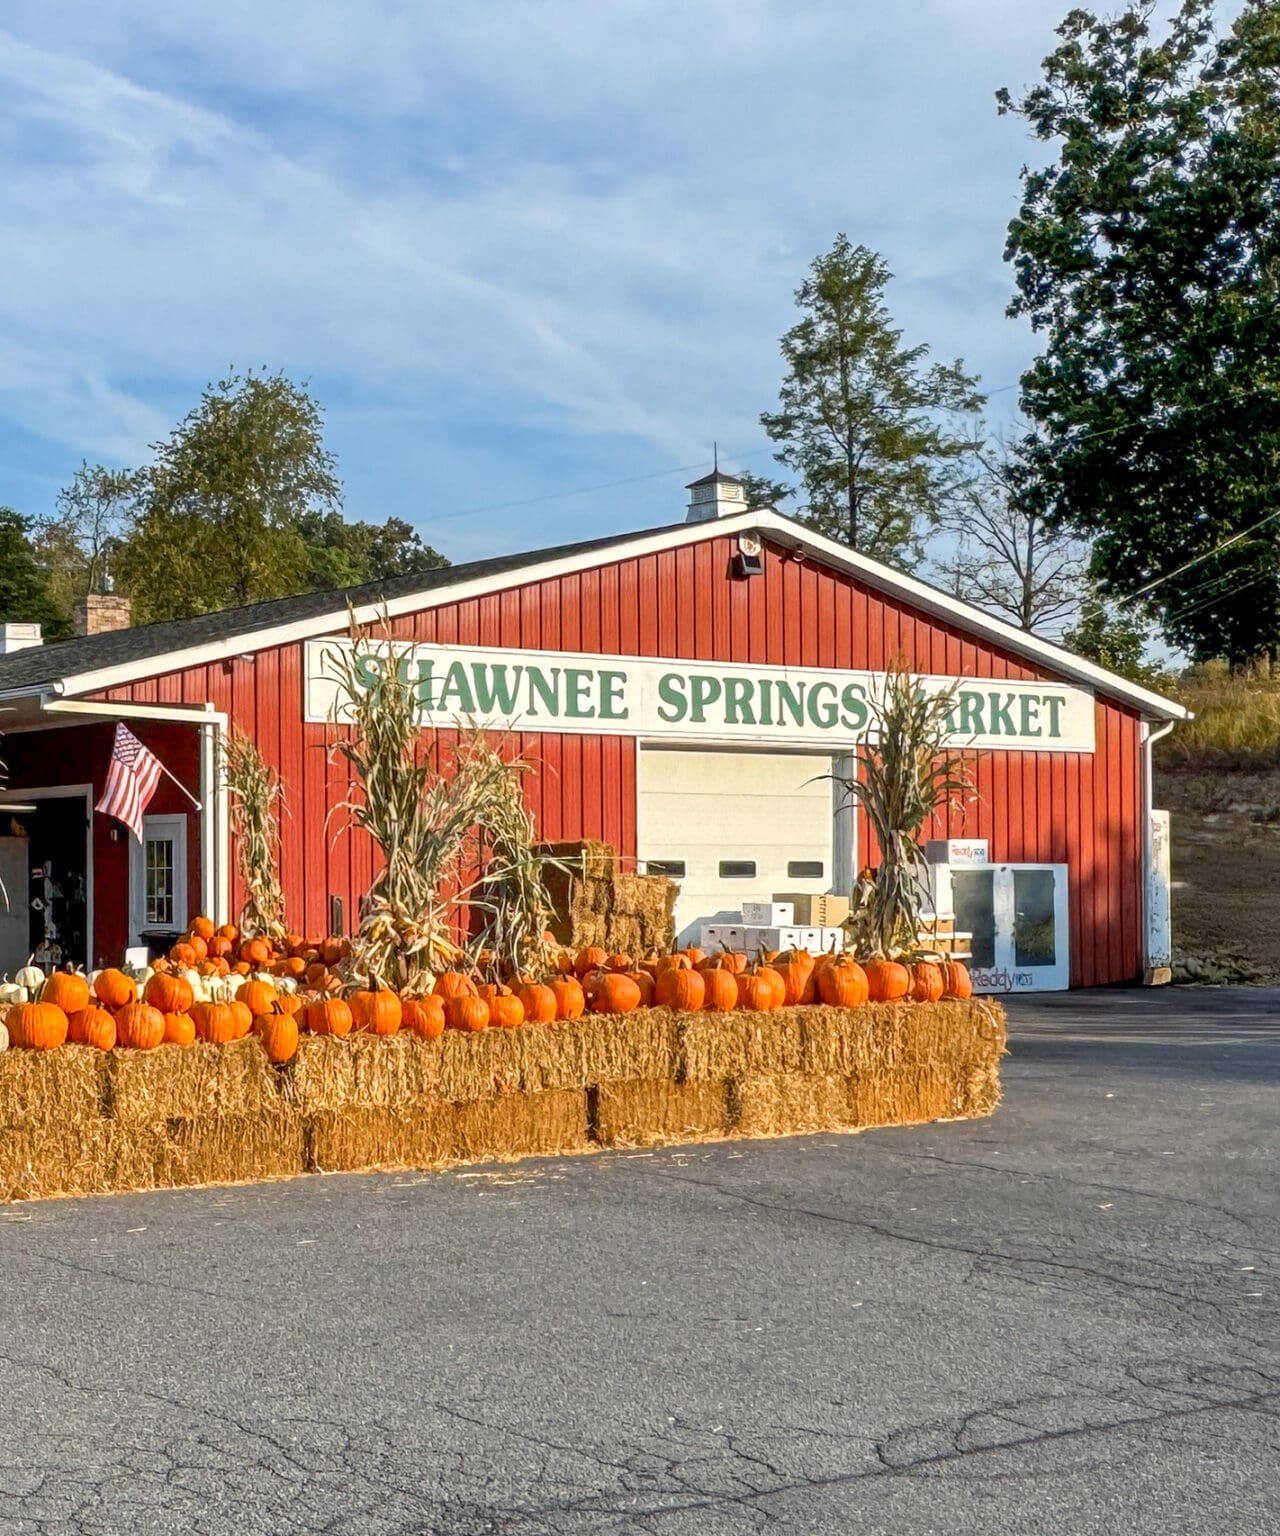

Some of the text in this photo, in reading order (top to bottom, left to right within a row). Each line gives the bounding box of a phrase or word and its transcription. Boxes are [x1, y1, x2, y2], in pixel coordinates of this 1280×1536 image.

[355, 653, 1066, 738] SHAWNEE SPRINGS RKET
[970, 965, 1015, 991] Reddy
